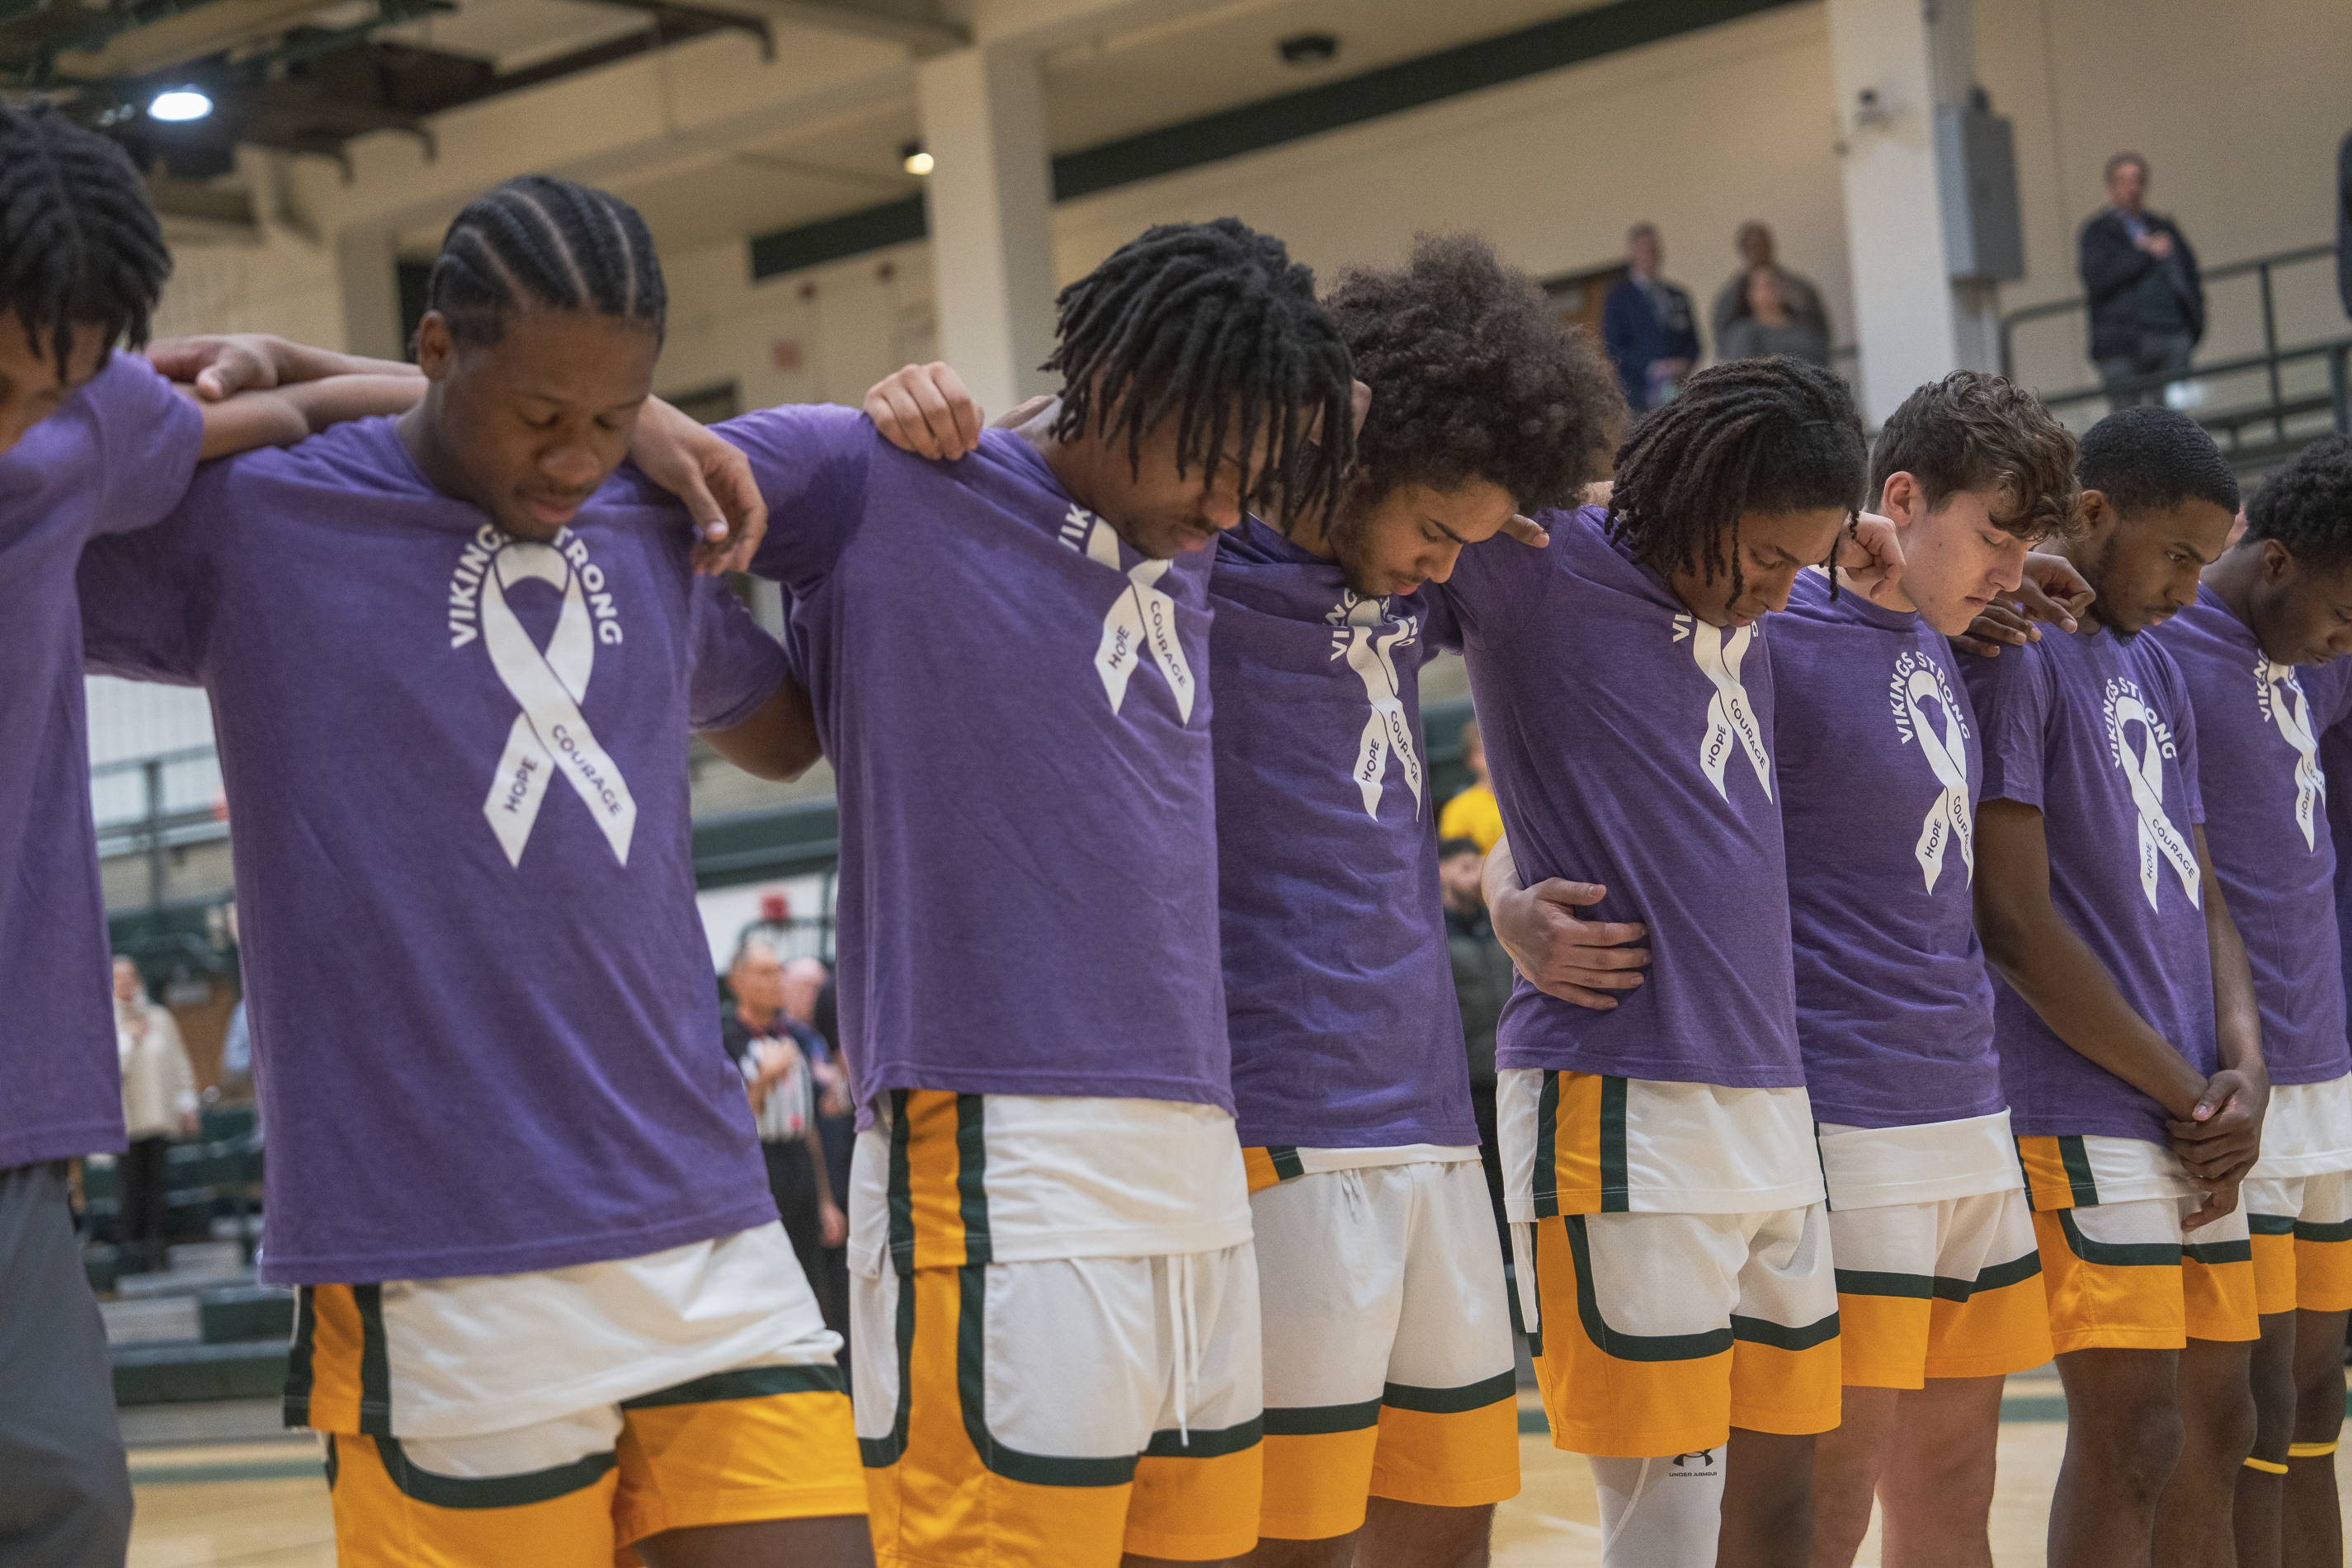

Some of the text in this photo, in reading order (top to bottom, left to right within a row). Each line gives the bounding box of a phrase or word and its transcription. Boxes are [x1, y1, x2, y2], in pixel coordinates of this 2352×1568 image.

[551, 525, 624, 646] TRONG
[1107, 624, 1130, 670] HOPE
[1150, 600, 1186, 688] COURAGE
[1889, 651, 1971, 745] VIKINGS STRONG
[2103, 678, 2120, 769] VIKINGS
[1362, 738, 1380, 783] HOPE
[1390, 710, 1419, 784] COURAGE
[1708, 723, 1727, 768] HOPE
[1730, 698, 1765, 770] COURAGE
[503, 756, 538, 814] HOPE
[551, 724, 623, 817] COURAGE
[2301, 784, 2311, 820] HOPE
[1924, 818, 1942, 859] HOPE
[2152, 818, 2195, 878] COURAGE
